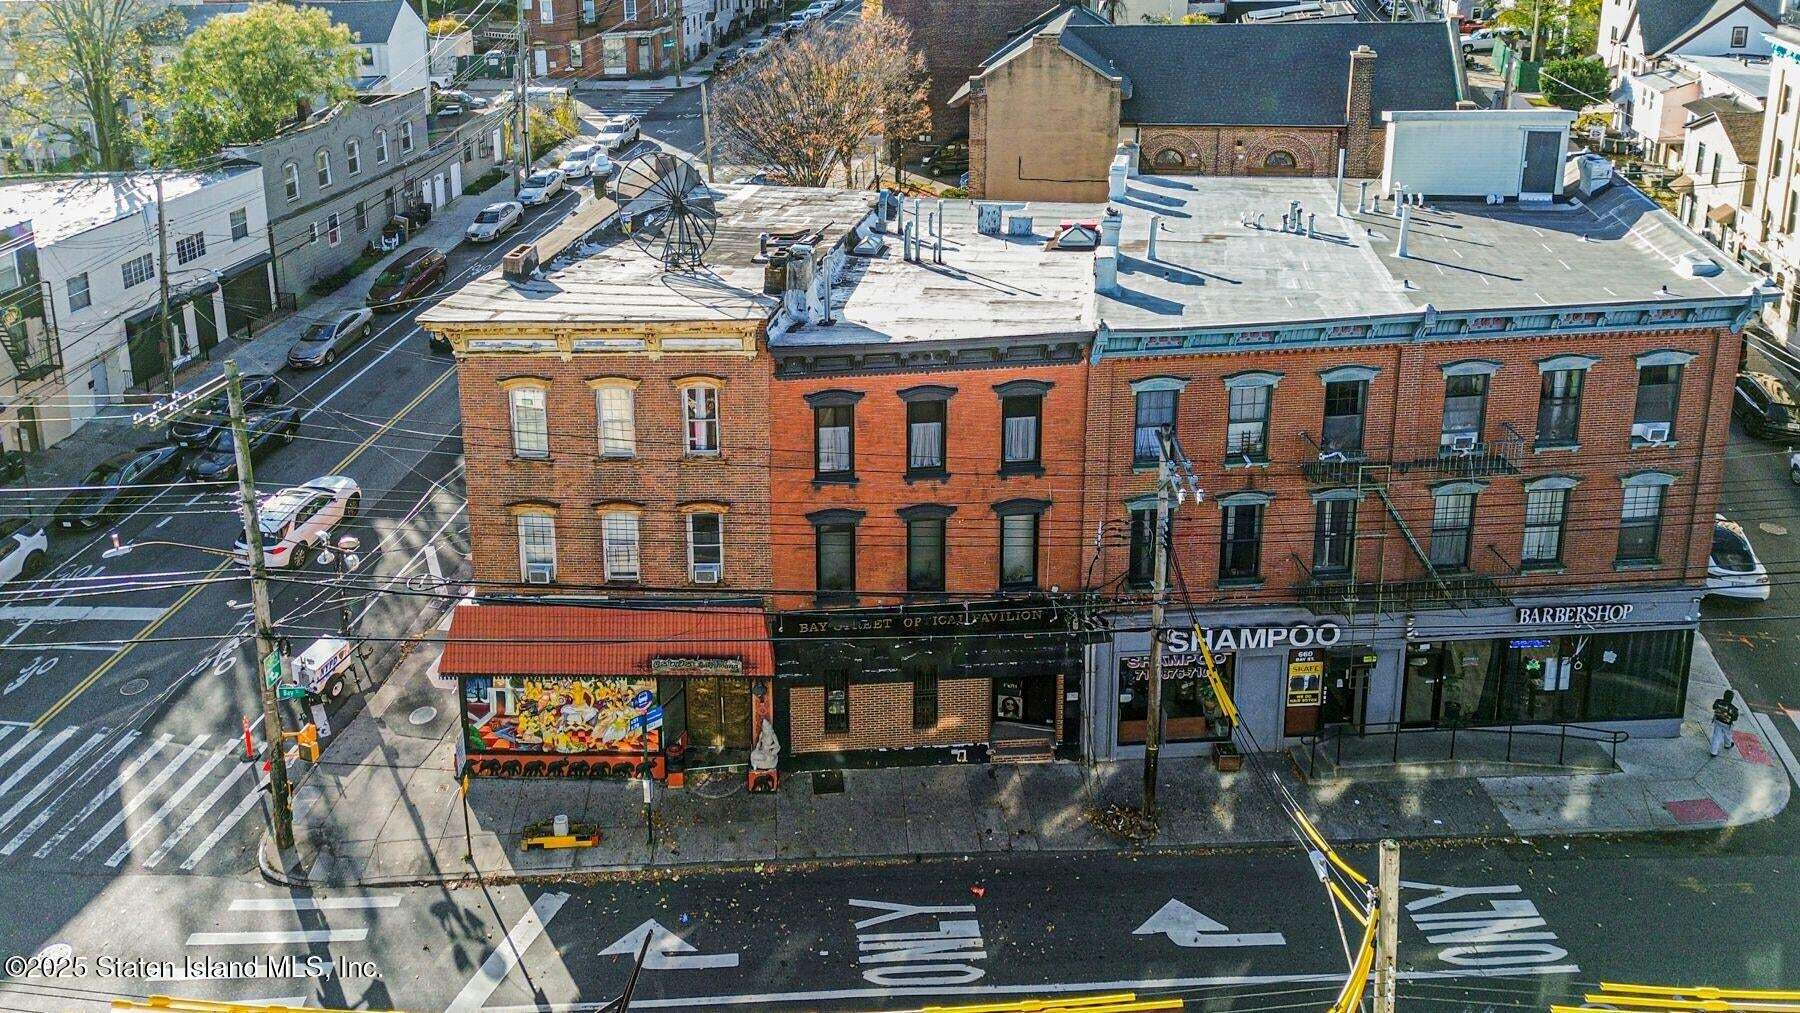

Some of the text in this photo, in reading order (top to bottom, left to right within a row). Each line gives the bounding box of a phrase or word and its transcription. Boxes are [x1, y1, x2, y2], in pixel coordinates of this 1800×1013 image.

[799, 622, 828, 633] BAY
[833, 618, 892, 631] EET
[903, 614, 965, 628] OPICAL
[1520, 604, 1633, 624] BARBERSHOP
[1168, 623, 1341, 652] SHAMPOO
[848, 898, 988, 986] ONLY
[1399, 879, 1568, 976] ONLY
